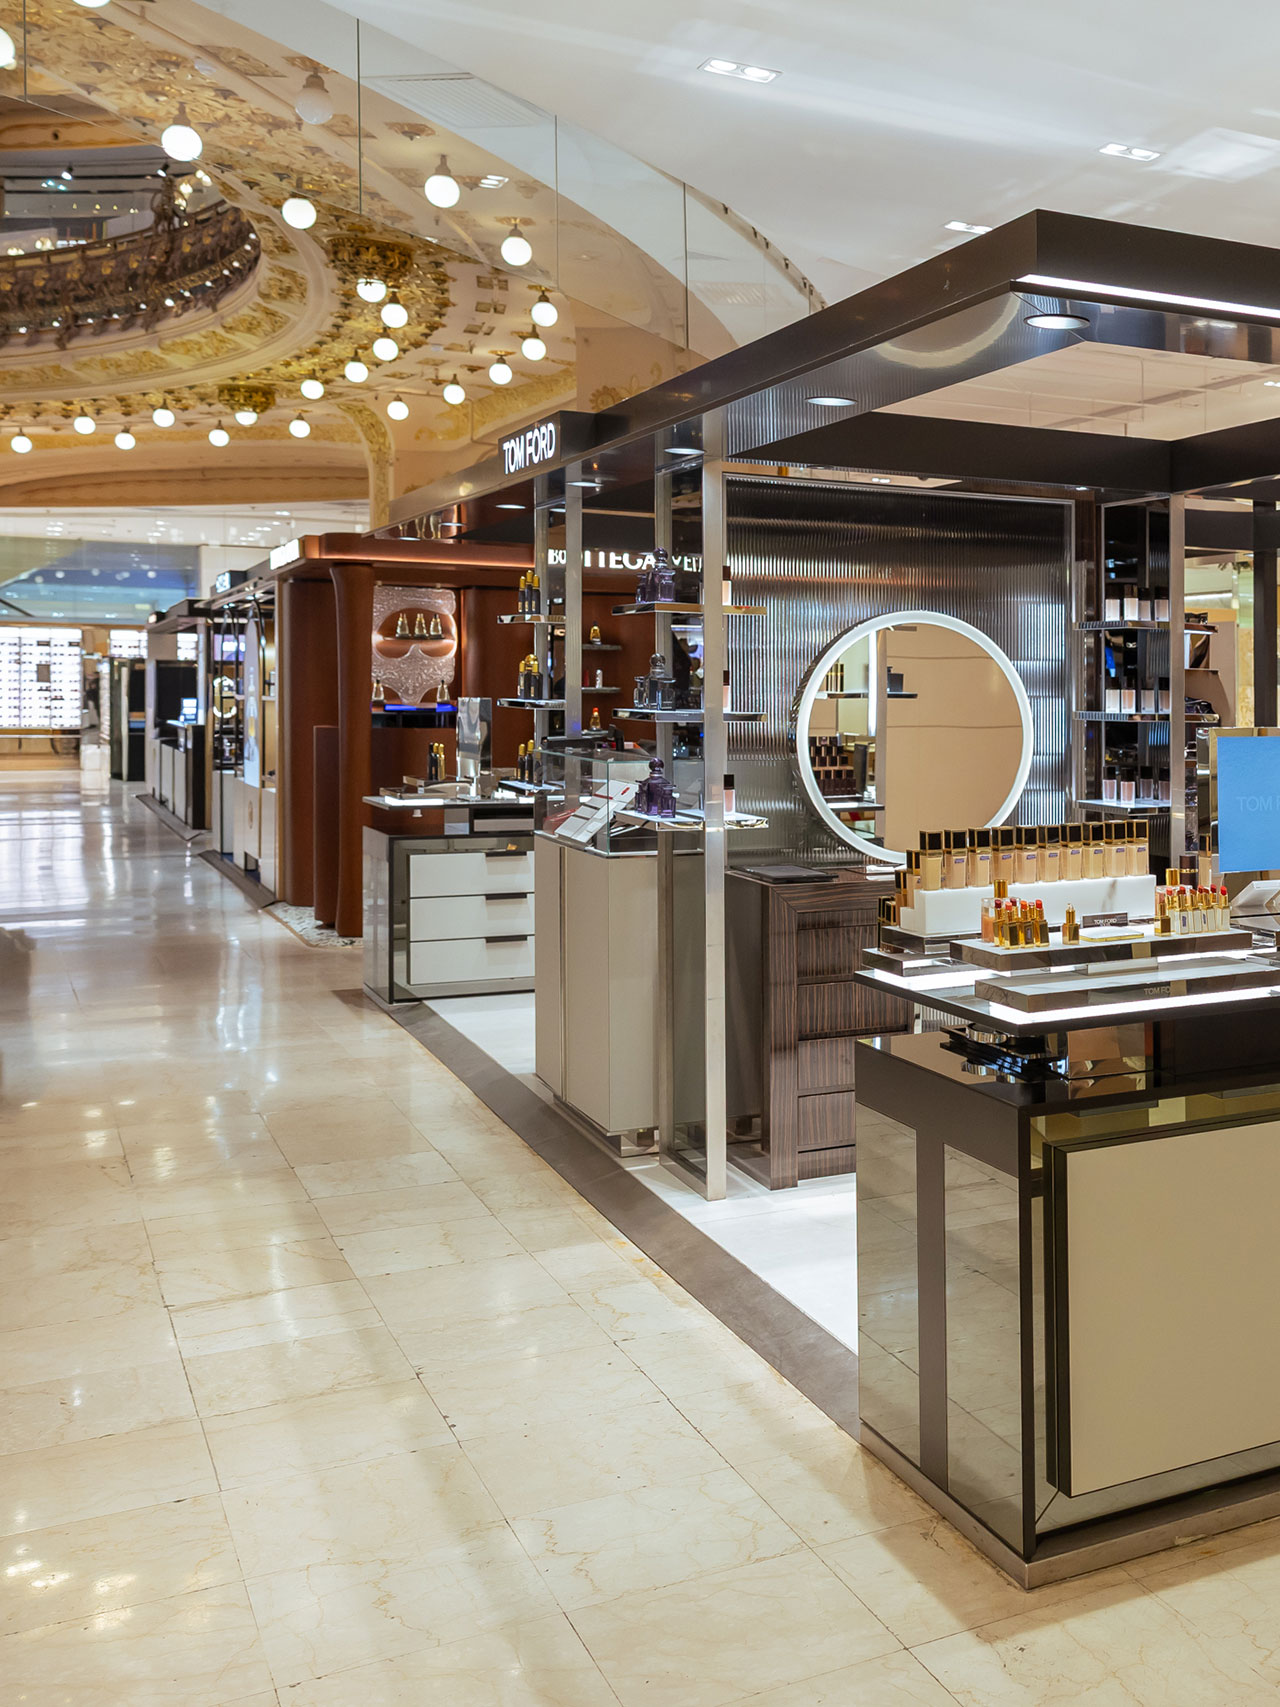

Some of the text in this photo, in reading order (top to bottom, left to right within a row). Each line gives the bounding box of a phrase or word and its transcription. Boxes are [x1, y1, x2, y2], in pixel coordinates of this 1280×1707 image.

[502, 422, 556, 474] TOM FORD
[1239, 796, 1273, 812] TOM
[1144, 988, 1160, 996] TOM
